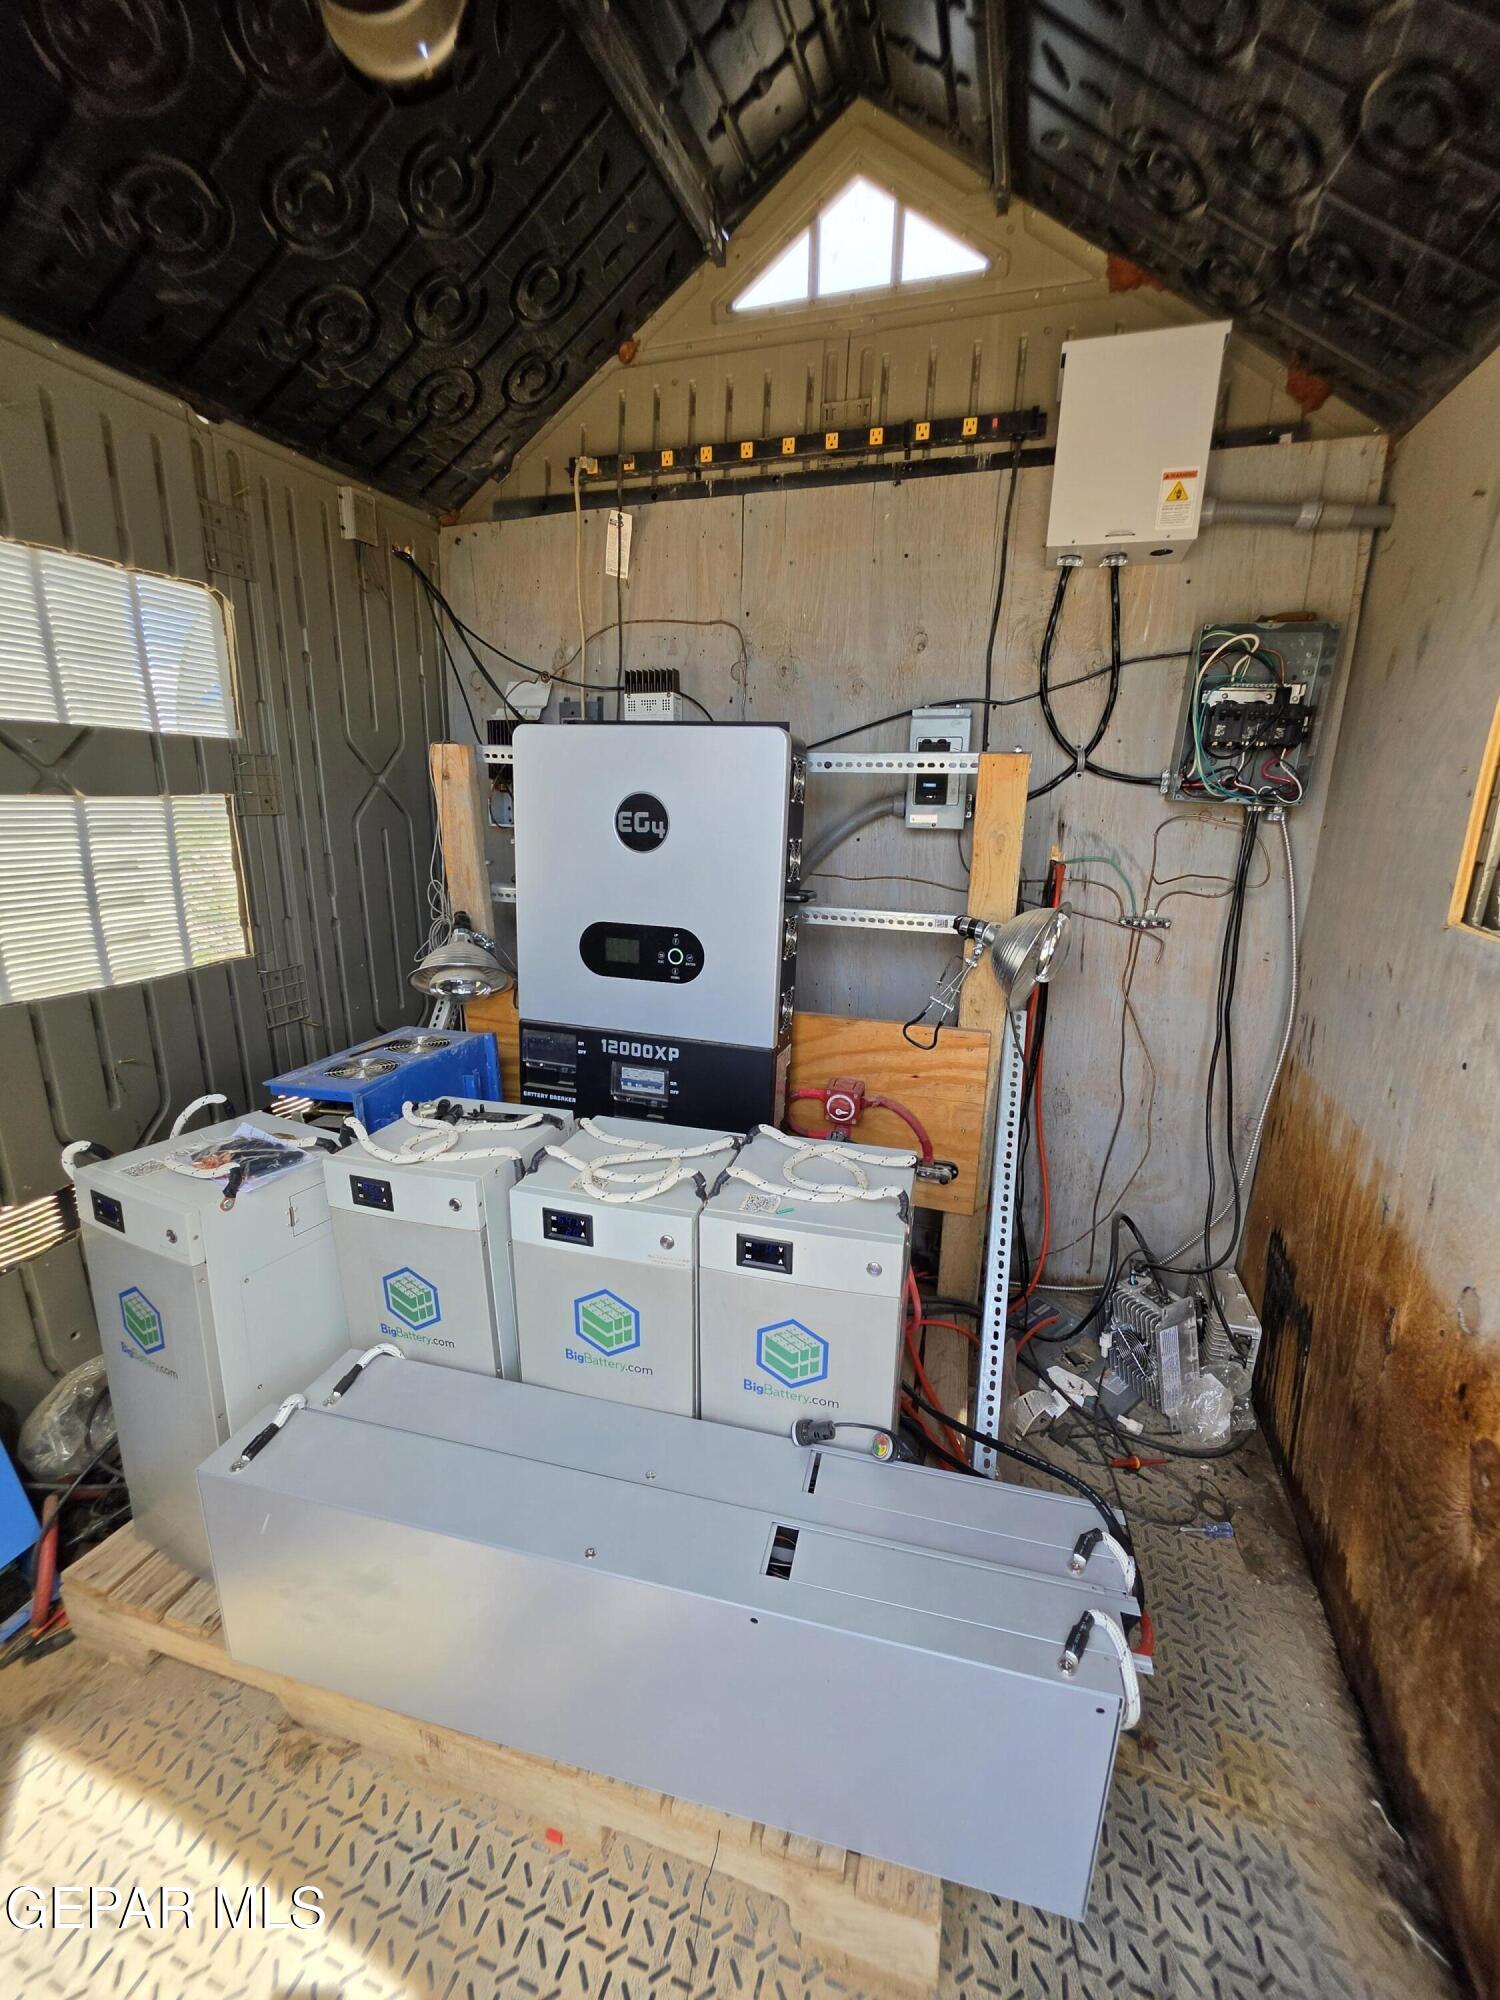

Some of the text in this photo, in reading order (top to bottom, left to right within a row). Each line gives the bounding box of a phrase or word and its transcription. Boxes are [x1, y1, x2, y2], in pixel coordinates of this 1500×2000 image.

[618, 811, 665, 839] EG4
[601, 1039, 680, 1061] 12000XP
[523, 1090, 576, 1103] BATTERY BREAKER
[380, 1323, 455, 1348] BigBattery.com
[565, 1348, 653, 1375] BigBattery.com
[743, 1378, 840, 1409] BigBattery.com
